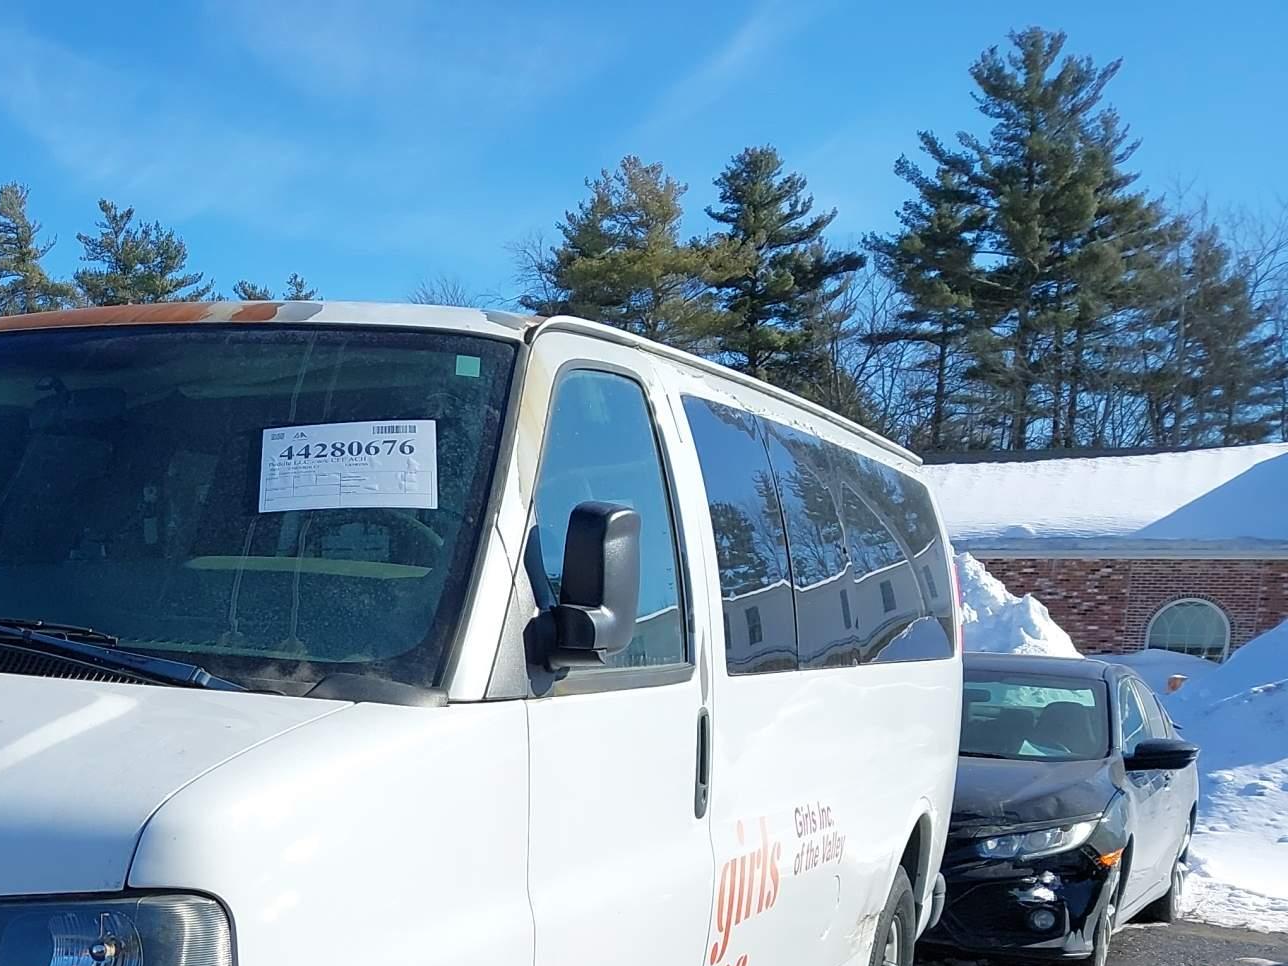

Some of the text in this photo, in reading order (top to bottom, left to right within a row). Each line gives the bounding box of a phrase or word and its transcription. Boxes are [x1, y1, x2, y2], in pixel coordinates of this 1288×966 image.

[279, 439, 415, 461] 44280676
[794, 800, 834, 838] Girls Inc.
[793, 831, 846, 876] of the Valley
[710, 816, 781, 965] girls
